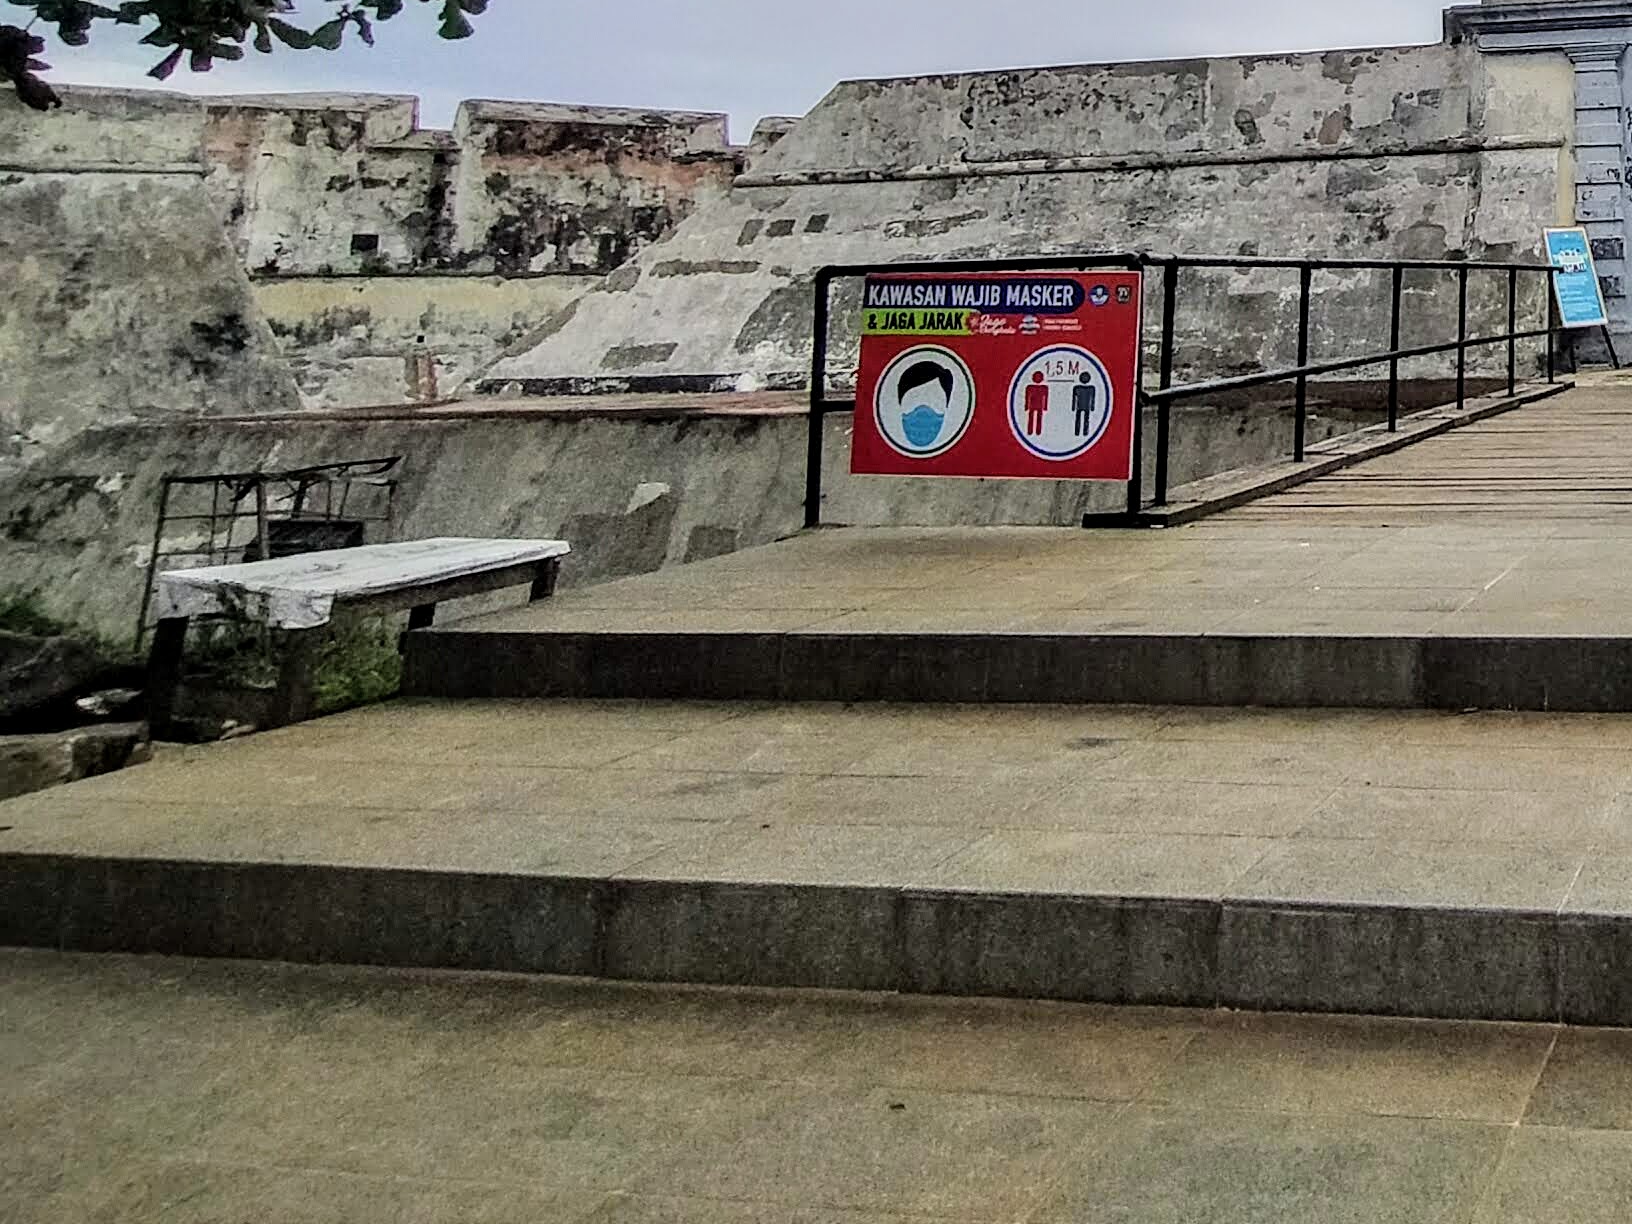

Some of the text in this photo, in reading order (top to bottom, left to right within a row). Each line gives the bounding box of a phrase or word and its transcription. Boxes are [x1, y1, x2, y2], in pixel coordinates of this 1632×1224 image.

[868, 284, 1074, 306] KAWASAN WAJIB MASKER
[867, 312, 965, 330] & JAGA JARAK
[1068, 360, 1080, 375] M
